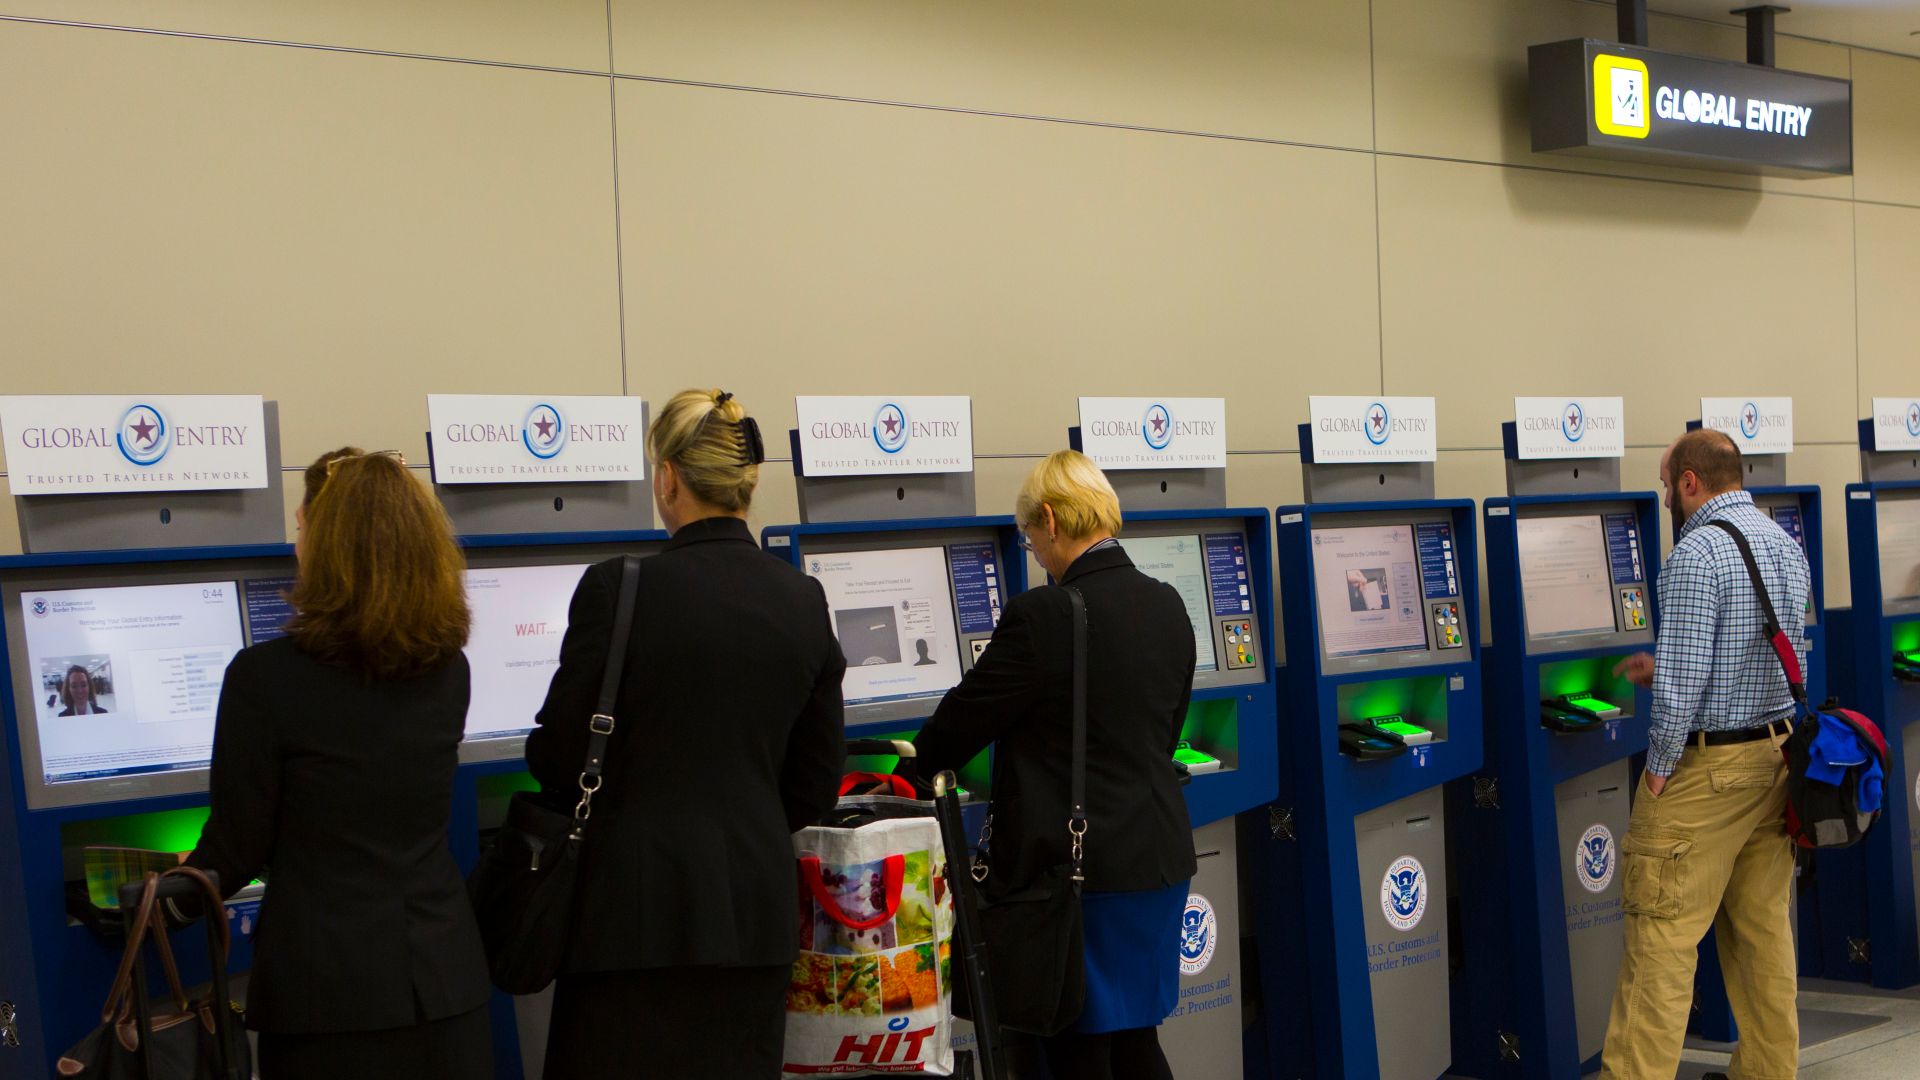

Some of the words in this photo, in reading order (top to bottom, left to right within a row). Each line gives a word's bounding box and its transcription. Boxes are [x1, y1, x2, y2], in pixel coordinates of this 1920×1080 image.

[1656, 86, 1741, 128] GLOBAL
[1746, 99, 1812, 136] ENTRY
[1092, 421, 1142, 436] GLOBAL
[1176, 421, 1216, 436] ENTRY
[1320, 418, 1363, 432] GLOBAL
[1392, 418, 1428, 432] ENTRY
[1524, 417, 1560, 430] GLOBAL
[1586, 416, 1616, 430] ENTRY
[1709, 416, 1738, 428] GLOBAL
[1760, 416, 1786, 428] ENTRY
[1879, 416, 1904, 426] GLOBAL
[22, 428, 112, 448] GLOBAL
[176, 426, 248, 447] ENTRY
[447, 424, 519, 442] GLOBAL
[570, 424, 629, 442] ENTRY
[812, 422, 870, 439] GLOBAL
[912, 422, 960, 438] ENTRY
[512, 465, 568, 474] TRAVELER
[26, 474, 94, 484] TRUSTED
[104, 472, 174, 482] TRAVELER
[183, 472, 250, 480] NETWORK
[202, 589, 224, 599] 0:44
[1568, 917, 1590, 931] order
[1388, 936, 1426, 952] Customs
[1402, 948, 1441, 967] Protection
[1180, 982, 1214, 998] ustoms
[1216, 974, 1231, 992] and
[1188, 992, 1232, 1014] Protection
[833, 1026, 936, 1063] HIT
